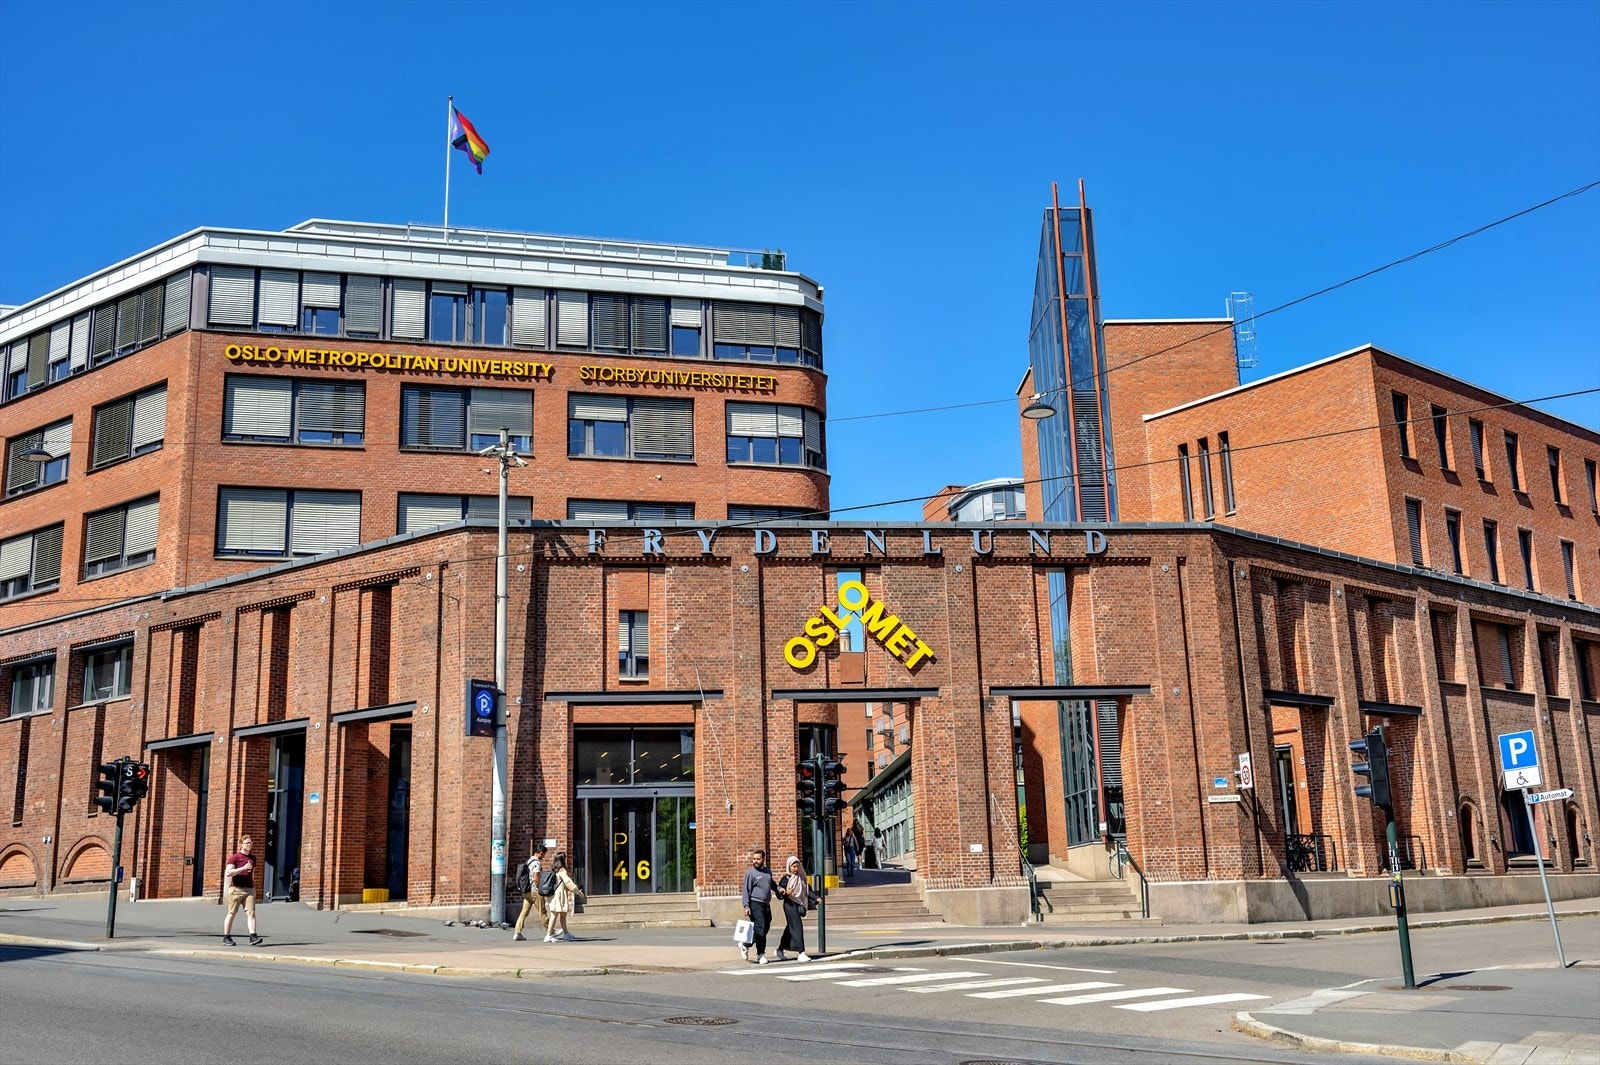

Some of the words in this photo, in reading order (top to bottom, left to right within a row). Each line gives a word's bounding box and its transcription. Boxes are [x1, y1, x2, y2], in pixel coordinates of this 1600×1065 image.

[224, 344, 282, 362] OSLO
[287, 348, 440, 371] METROPOLITAN
[444, 357, 553, 378] UNIVERSITY
[579, 365, 777, 391] STORBYUNIVERSITETET
[586, 529, 1108, 555] FRYDENLUND
[783, 579, 935, 670] OSLOMET
[1508, 737, 1528, 766] P
[1540, 791, 1568, 801] Automat
[614, 832, 628, 852] P
